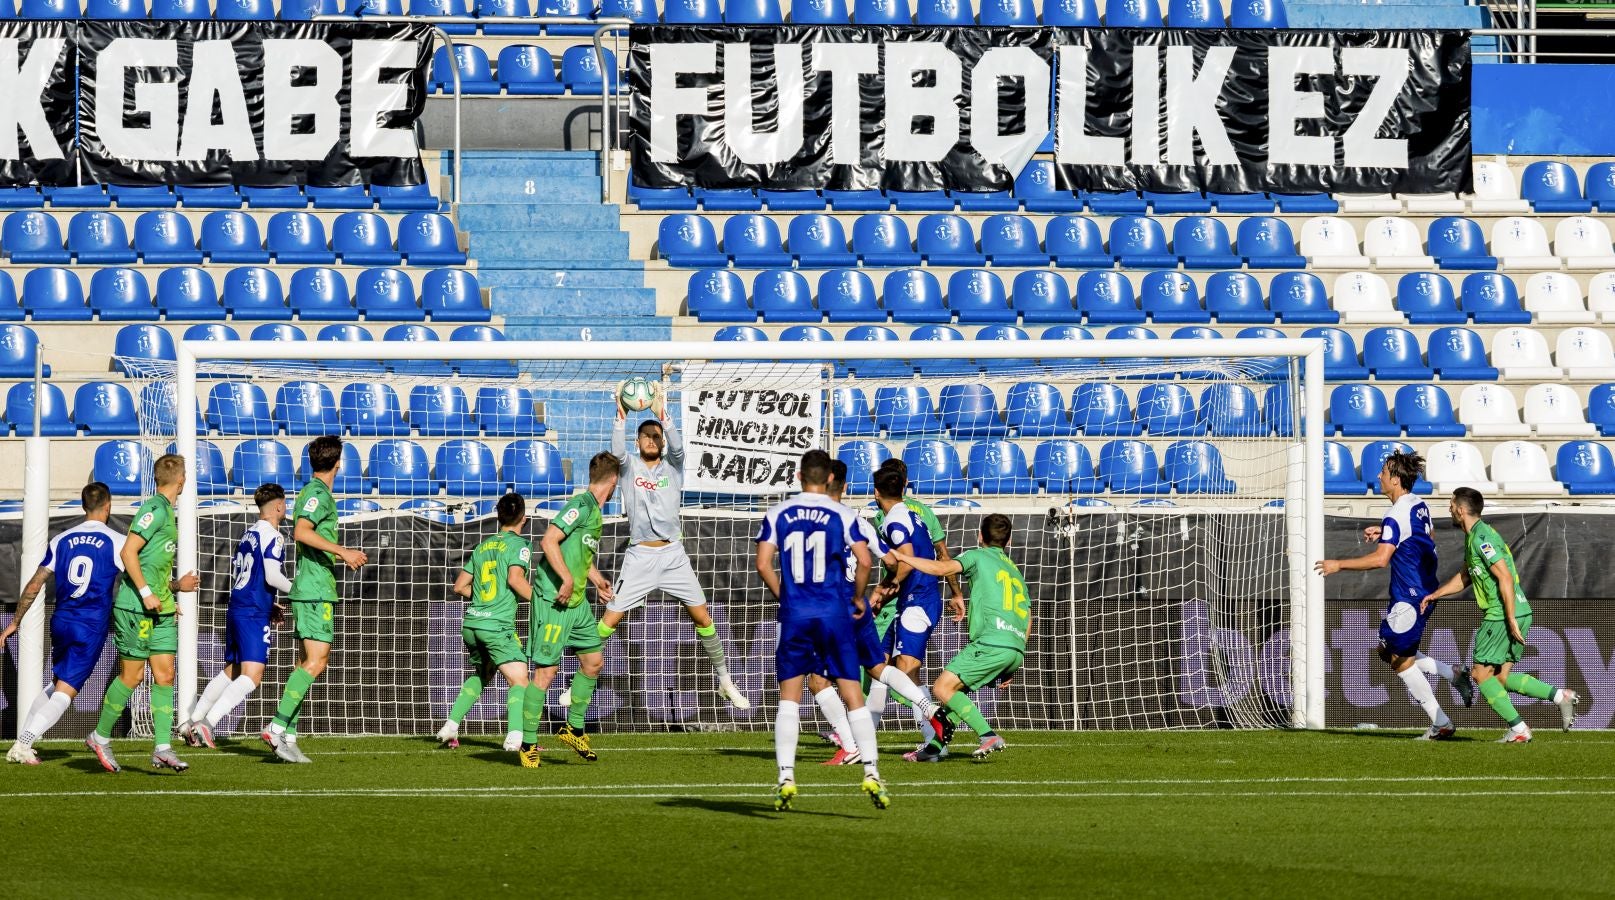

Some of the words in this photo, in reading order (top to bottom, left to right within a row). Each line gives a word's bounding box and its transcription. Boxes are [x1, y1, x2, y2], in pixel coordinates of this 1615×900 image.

[96, 37, 419, 161] GABE
[649, 41, 1241, 168] FUTBOLIK
[1267, 45, 1410, 169] EZ
[524, 180, 536, 195] 8
[555, 272, 567, 287] 7
[580, 327, 592, 342] 6
[696, 415, 815, 450] HINCHAS
[696, 452, 797, 489] NADA
[784, 507, 831, 526] L.RIOJA
[68, 535, 105, 550] JOSELU
[784, 531, 827, 584] 11
[67, 555, 94, 599] 9
[481, 560, 498, 602] 5
[995, 569, 1028, 620] 12
[322, 603, 333, 622] 3
[544, 623, 562, 644] 17
